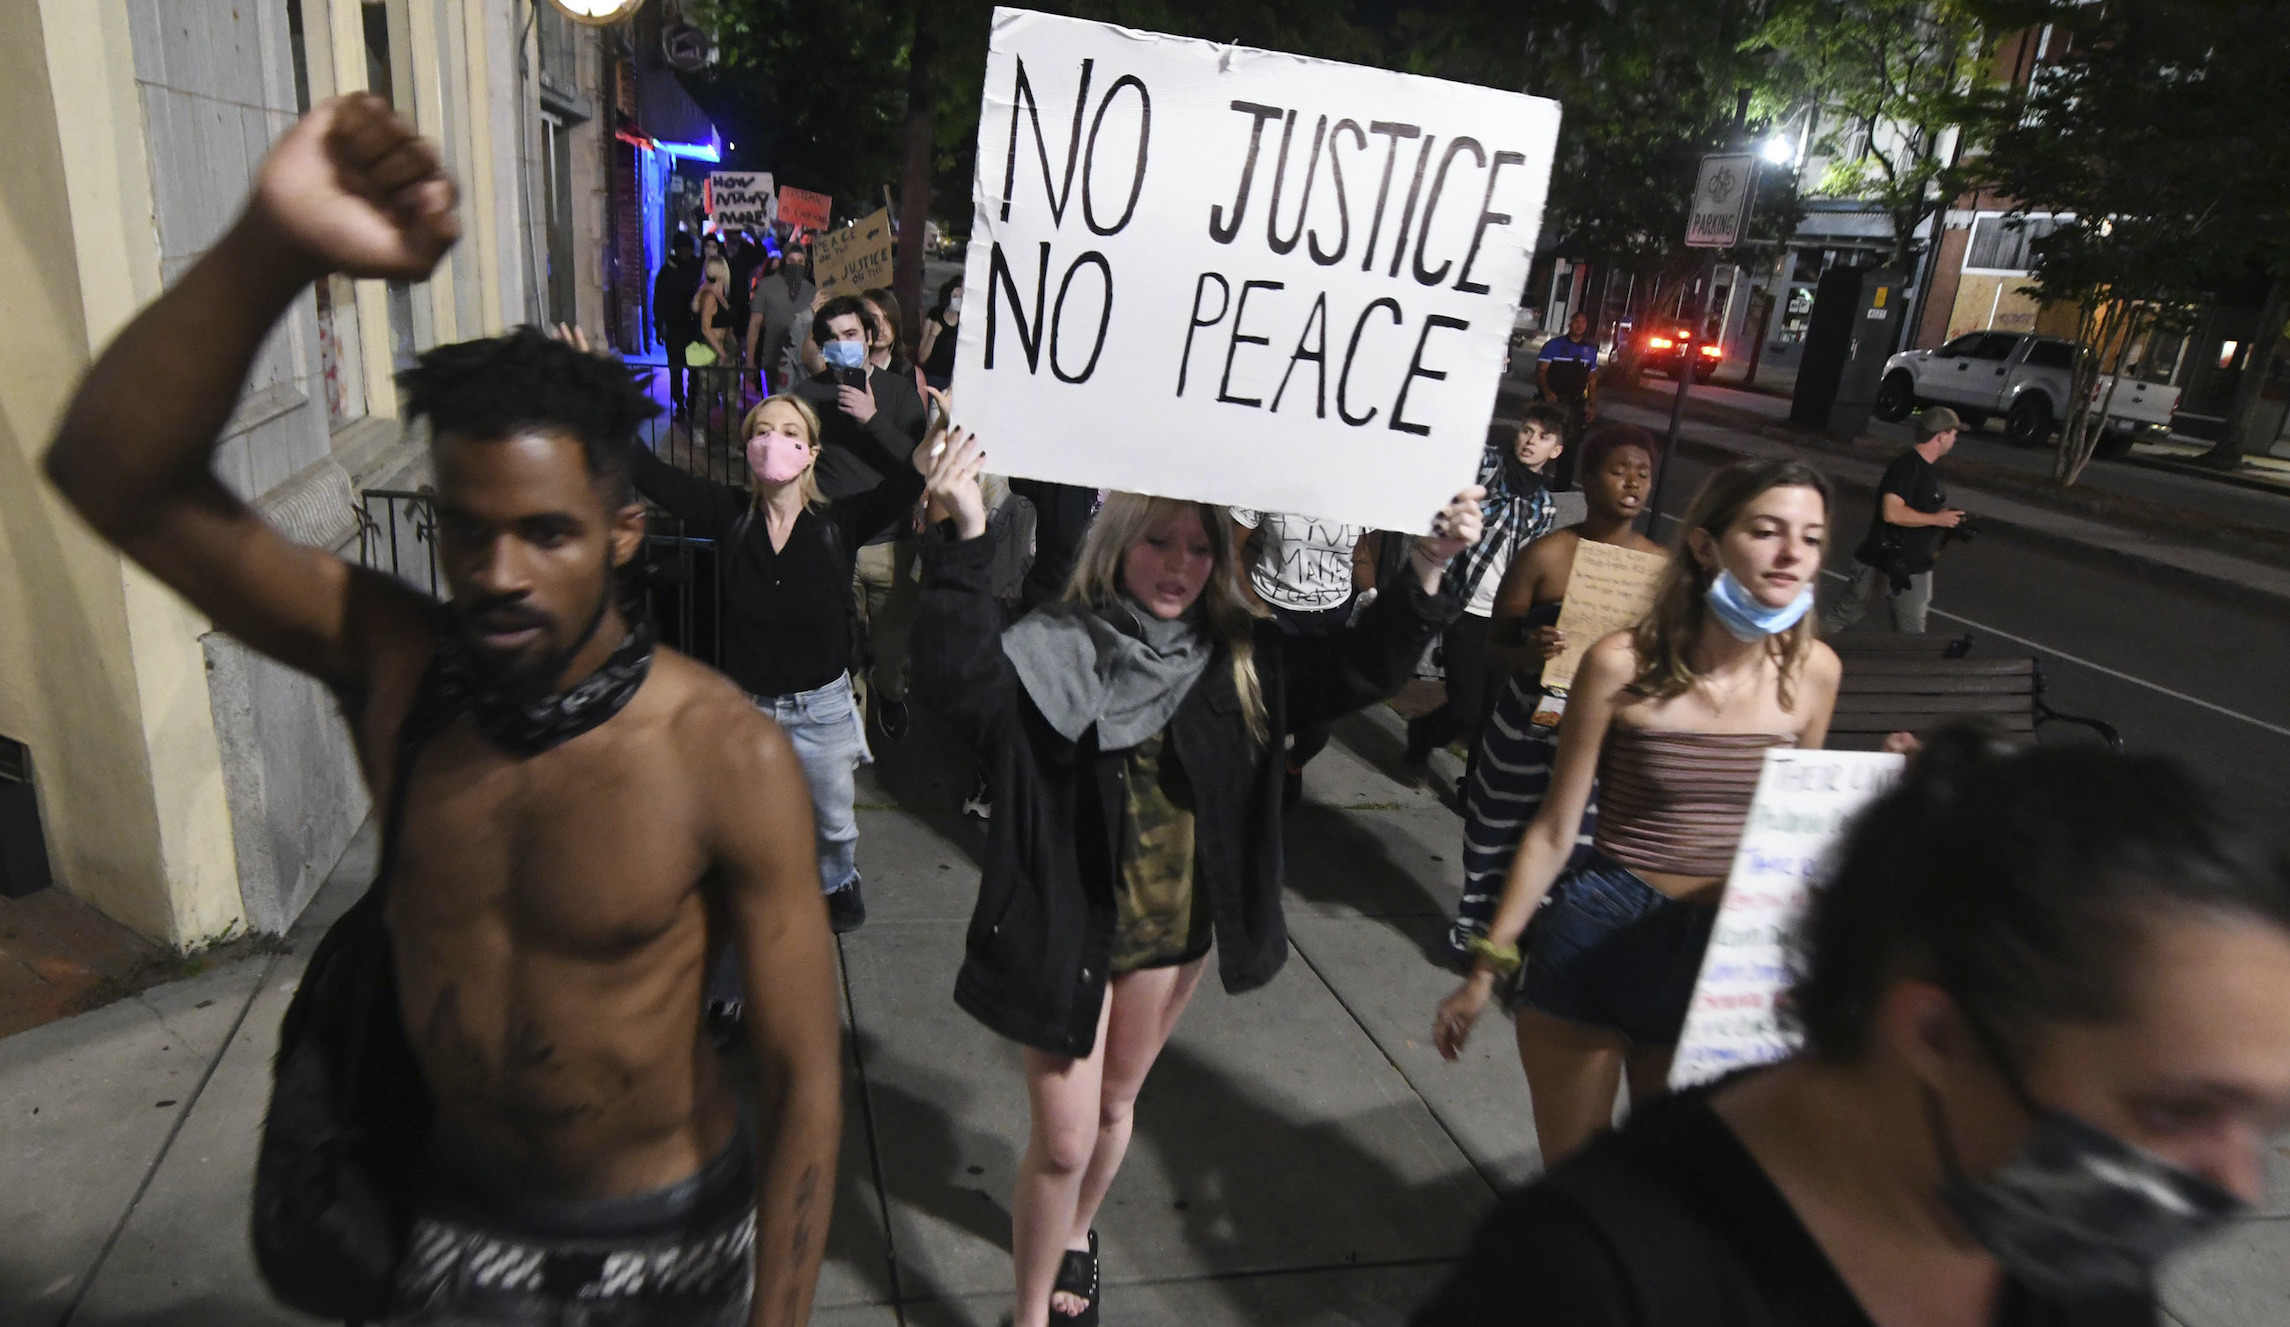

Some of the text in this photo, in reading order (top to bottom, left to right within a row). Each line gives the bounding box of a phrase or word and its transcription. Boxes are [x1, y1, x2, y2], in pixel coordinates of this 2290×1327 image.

[713, 176, 755, 189] HOW
[1000, 52, 1526, 295] NO JUSTICE
[715, 190, 770, 209] MANY
[1691, 213, 1734, 235] PARKING
[814, 229, 857, 256] PEACE
[841, 248, 888, 280] JUSTICE
[852, 273, 865, 284] ON
[984, 241, 1470, 437] NO PEACE
